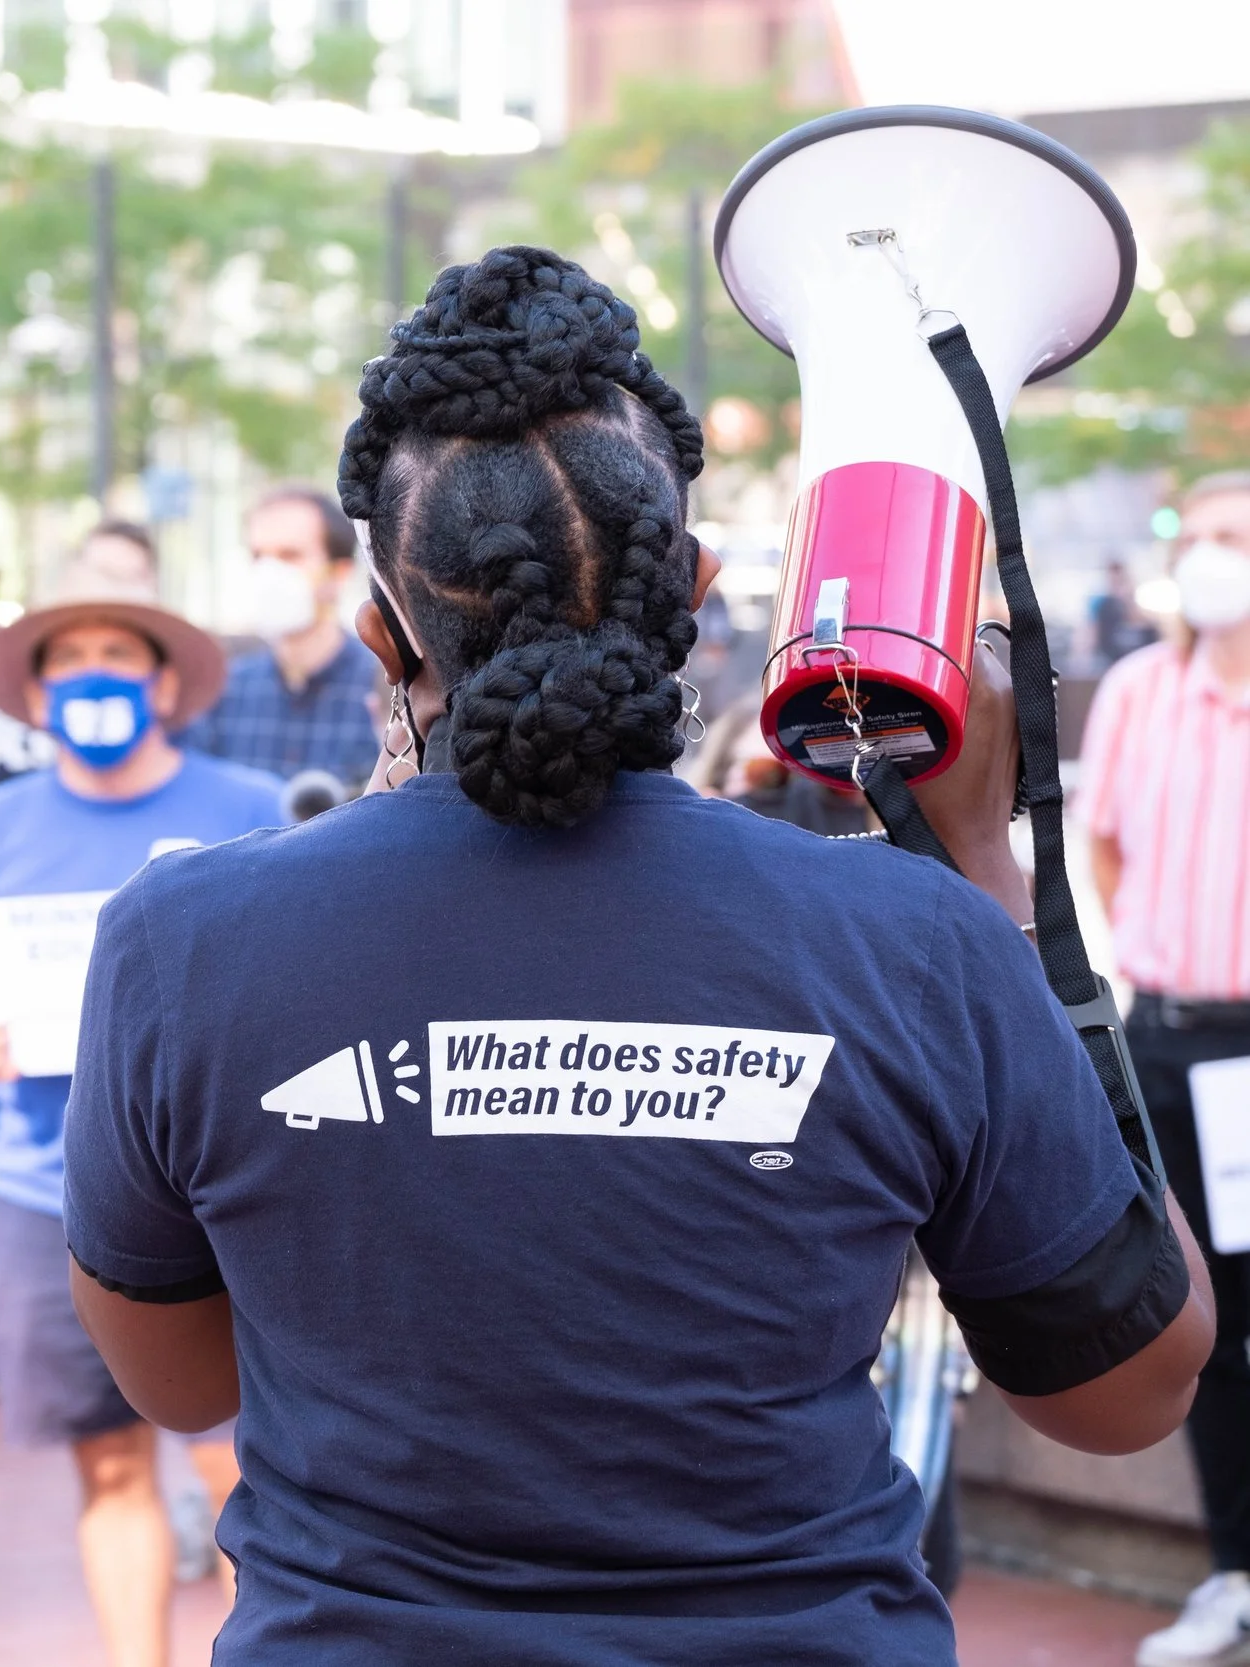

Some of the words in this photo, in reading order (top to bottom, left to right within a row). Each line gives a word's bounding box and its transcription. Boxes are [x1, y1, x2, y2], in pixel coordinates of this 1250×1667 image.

[791, 720, 844, 731] Megaphone
[866, 713, 895, 722] Safety
[897, 711, 922, 719] Siren
[446, 1033, 551, 1072] What
[559, 1033, 662, 1074] does
[671, 1040, 806, 1089] safety
[444, 1087, 560, 1117] mean
[570, 1081, 612, 1117] to
[619, 1085, 726, 1128] you?
